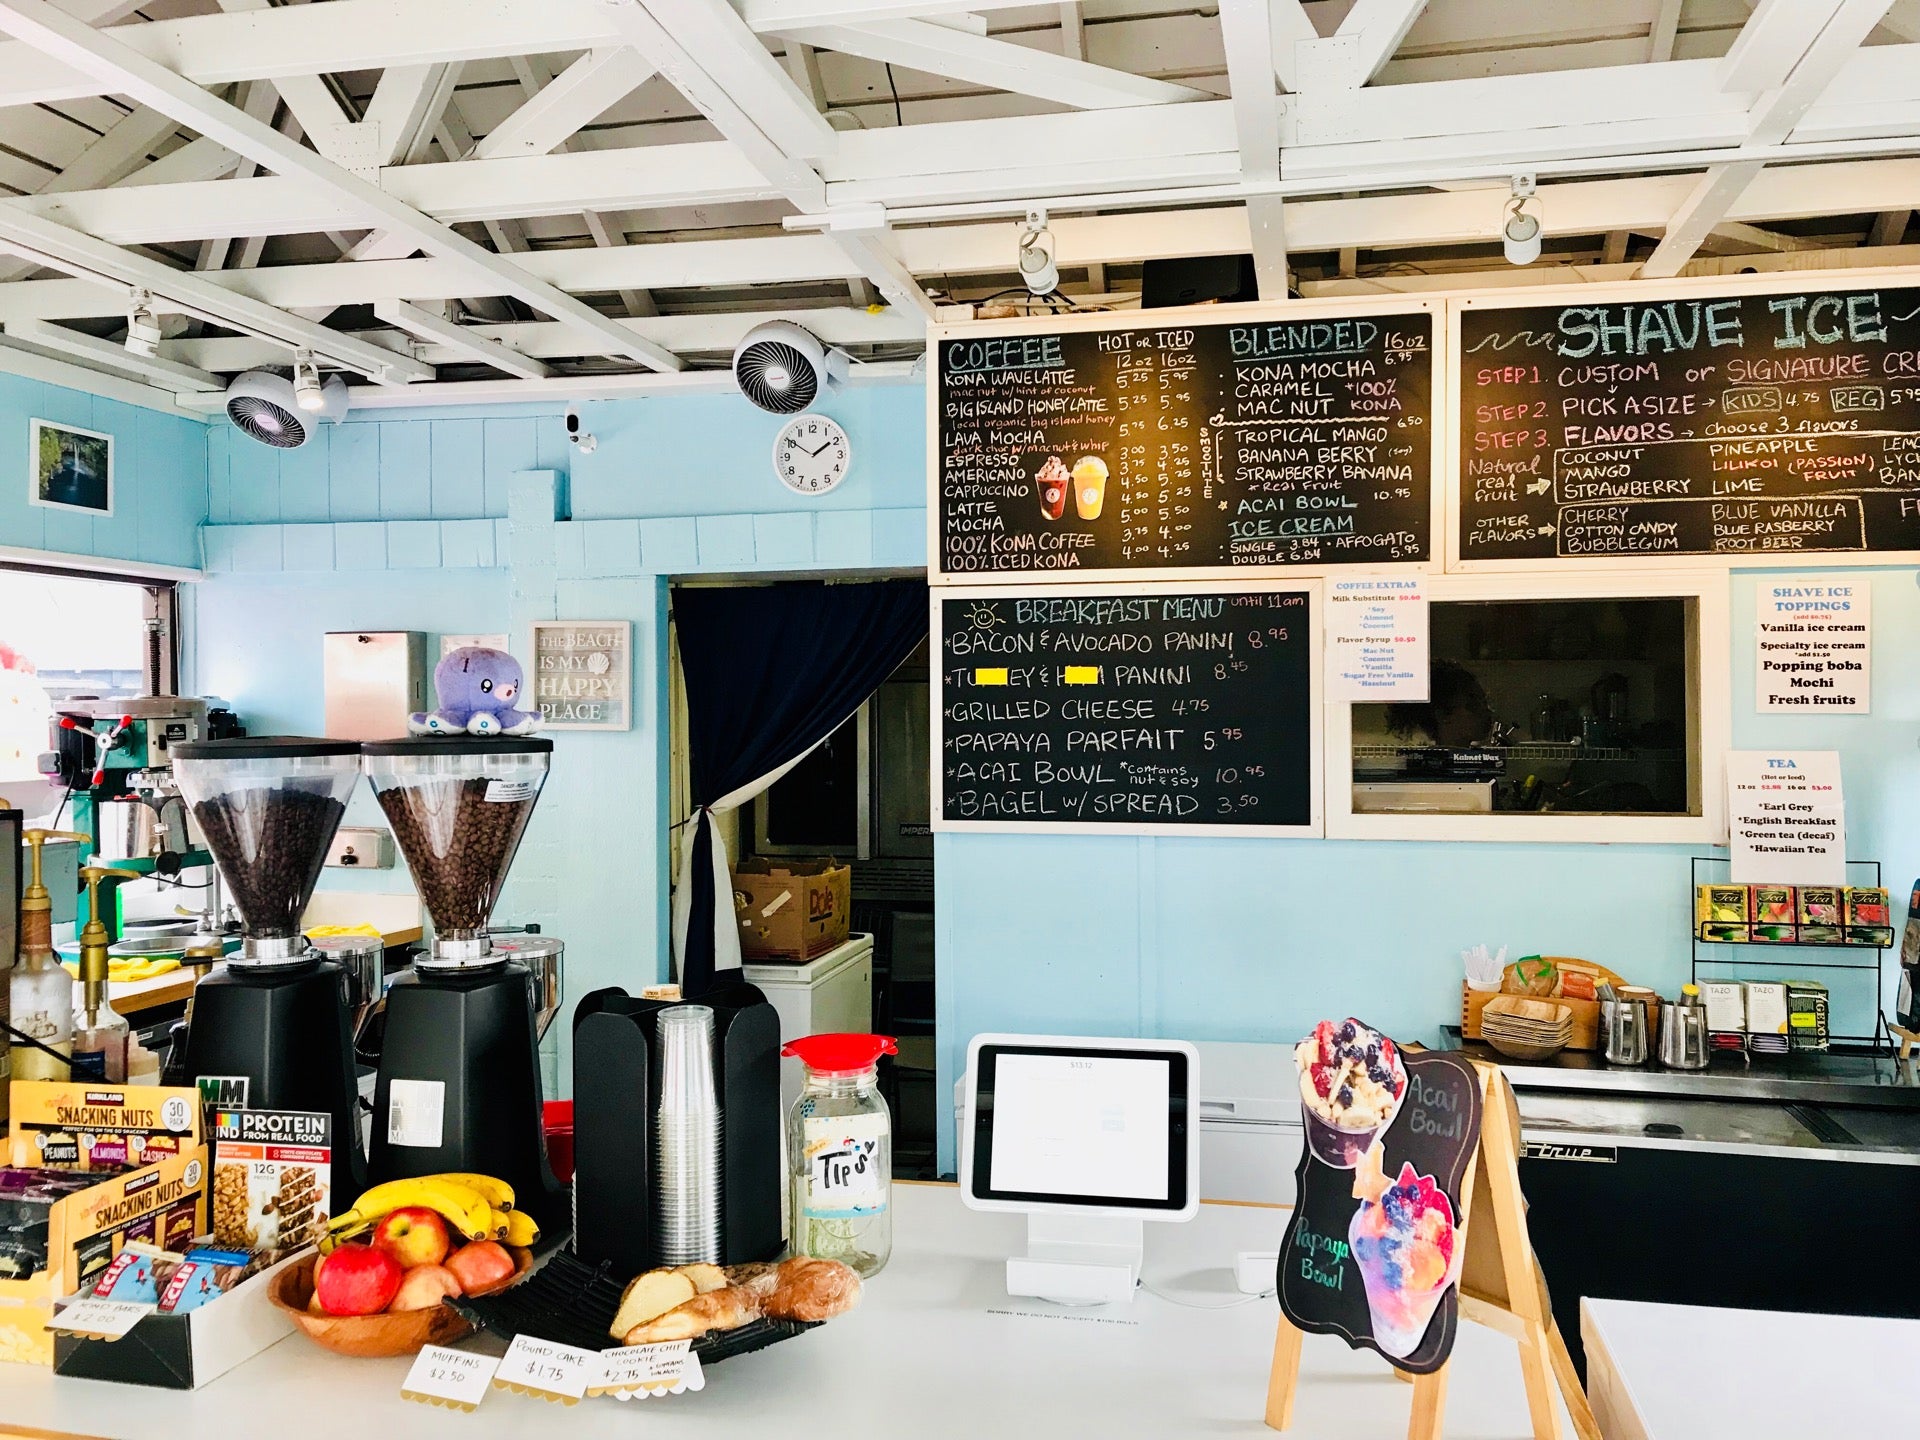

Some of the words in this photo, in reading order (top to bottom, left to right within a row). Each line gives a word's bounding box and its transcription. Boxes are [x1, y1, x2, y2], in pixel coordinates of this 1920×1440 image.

[1557, 299, 1744, 358] SHAVE
[1768, 292, 1888, 350] ICE
[1098, 332, 1134, 351] HOT
[1155, 330, 1194, 349] ICED
[1229, 320, 1378, 355] BLENDED
[948, 337, 1063, 370] COFFEE
[944, 370, 986, 386] KONA
[991, 371, 1031, 386] WAVE
[1033, 369, 1076, 385] LATTE
[1236, 363, 1294, 382] KONA
[1301, 359, 1376, 380] MOCHA
[1476, 366, 1527, 386] STEP
[1558, 361, 1660, 387] CUSTOM
[1727, 353, 1870, 382] SIGNATURE
[1235, 381, 1333, 399] CARAMEL
[945, 400, 975, 418] BIG
[975, 399, 1024, 416] ISLAND
[1027, 398, 1068, 414] HONEY
[1069, 397, 1109, 413] LATTE
[1237, 398, 1283, 417] MAC
[1290, 398, 1335, 415] NUT
[1350, 397, 1402, 411] KONA
[1475, 404, 1528, 424] STEP
[1562, 397, 1617, 418] PICK
[1642, 393, 1697, 416] SIZE
[944, 431, 982, 447] LAVA
[990, 430, 1045, 444] MOCHA
[1235, 427, 1327, 445] TROPICAL
[1332, 427, 1388, 443] MANGO
[1475, 430, 1530, 452] STEP
[1564, 423, 1674, 447] FLAVORS
[1775, 416, 1790, 433] 3
[1796, 417, 1859, 432] flavors
[1237, 448, 1310, 465] BANANA
[1317, 445, 1378, 463] BERRY
[1562, 448, 1646, 465] COCONUT
[1709, 439, 1820, 457] PINEAPPLE
[945, 453, 1019, 468] ESPRESSO
[1712, 459, 1779, 472] LILIKOI
[945, 468, 1026, 484] AMERICANO
[1235, 464, 1338, 481] STRAWBERRY
[1342, 464, 1413, 481] BANANA
[1565, 464, 1631, 483] MANGO
[944, 485, 1029, 499] CAPPUCCINO
[1564, 478, 1692, 499] STRAWBERRY
[1712, 478, 1766, 495] LIME
[947, 502, 998, 516] LATTE
[1237, 498, 1285, 515] ACAI
[1296, 495, 1359, 509] BOWL
[1711, 503, 1761, 521] BLUE
[1770, 502, 1847, 519] VANILLA
[947, 515, 1005, 532] MOCHA
[1564, 507, 1630, 524] CHERRY
[1228, 519, 1274, 538] ICE
[1278, 515, 1355, 535] CREAM
[1564, 525, 1625, 538] COTTON
[1629, 522, 1679, 537] CANDY
[1713, 524, 1751, 537] BLUE
[1755, 520, 1836, 536] RASBERRY
[990, 533, 1036, 553] KONA
[1038, 532, 1096, 551] COFFEE
[1335, 530, 1417, 549] AFFOGATO
[1567, 536, 1679, 553] BUBBLEGUM
[1715, 538, 1756, 551] ROOT
[1762, 536, 1803, 549] BEER
[991, 553, 1030, 570] ICED
[1034, 553, 1080, 568] KONA
[1336, 582, 1374, 590] COFFEE
[1376, 581, 1417, 589] EXTRAS
[1772, 587, 1824, 597] SHAVE
[1827, 587, 1853, 597] ICE
[1015, 599, 1159, 625] BREAKFAST
[1163, 598, 1227, 622] MENU
[1774, 601, 1851, 611] TOPPINGS
[1760, 623, 1805, 632] Vanilla
[1807, 623, 1825, 632] ice
[1827, 624, 1866, 632] cream
[541, 637, 565, 647] THE
[566, 633, 619, 647] BEACH
[952, 631, 1035, 655] BACON
[1054, 632, 1153, 653] AVOCADO
[1164, 632, 1235, 651] PANINI
[1760, 641, 1811, 651] Specialty
[1813, 641, 1829, 650] ice
[540, 656, 554, 669] IS
[559, 656, 585, 669] MY
[1763, 660, 1824, 672] Popping
[1827, 660, 1863, 671] boba
[951, 666, 1036, 689] TUEY
[1115, 665, 1192, 684] PANINI
[1790, 677, 1834, 687] Mochi
[540, 677, 617, 697] HAPPY
[1768, 694, 1810, 705] Fresh
[1813, 694, 1856, 705] fruits
[539, 703, 601, 720] PLACE
[952, 699, 1051, 722] GRILLED
[1062, 700, 1157, 720] CHEESE
[955, 732, 1051, 754] PAPAYA
[1067, 728, 1185, 751] PARFAIT
[957, 763, 1022, 783] ACAI
[1034, 761, 1117, 784] BOWL
[1767, 759, 1797, 769] TEA
[959, 790, 1058, 817] BAGEL
[1094, 793, 1200, 816] SPREAD
[1788, 803, 1814, 812] Grey
[1784, 817, 1837, 826] Breakfast
[1778, 831, 1795, 839] tea
[1797, 831, 1836, 841] (decaf)
[1807, 845, 1826, 854] Tea
[1713, 892, 1740, 902] Tea
[1758, 890, 1785, 902] Tea
[1805, 892, 1832, 903] Tea
[1852, 892, 1879, 903] Tea
[86, 1093, 124, 1102] KIRKLAND
[1407, 1073, 1459, 1112] Acai
[56, 1106, 117, 1126] SNACKING
[121, 1109, 154, 1127] NUTS
[169, 1102, 184, 1117] 30
[243, 1114, 325, 1135] PROTEIN
[1410, 1108, 1462, 1142] Bowl
[243, 1131, 270, 1140] FROM
[271, 1132, 294, 1141] REAL
[296, 1133, 323, 1142] FOOD
[44, 1146, 77, 1160] PEANUTS
[91, 1147, 126, 1161] ALMONDS
[95, 1191, 152, 1229] SNACKING
[156, 1178, 183, 1201] NUTS
[1296, 1217, 1350, 1266] Papaya
[103, 1254, 135, 1293] CLIF
[1301, 1258, 1344, 1291] Bowl
[430, 1351, 480, 1370] MUFFINS
[516, 1339, 553, 1358] POUND
[556, 1351, 587, 1366] CAKE
